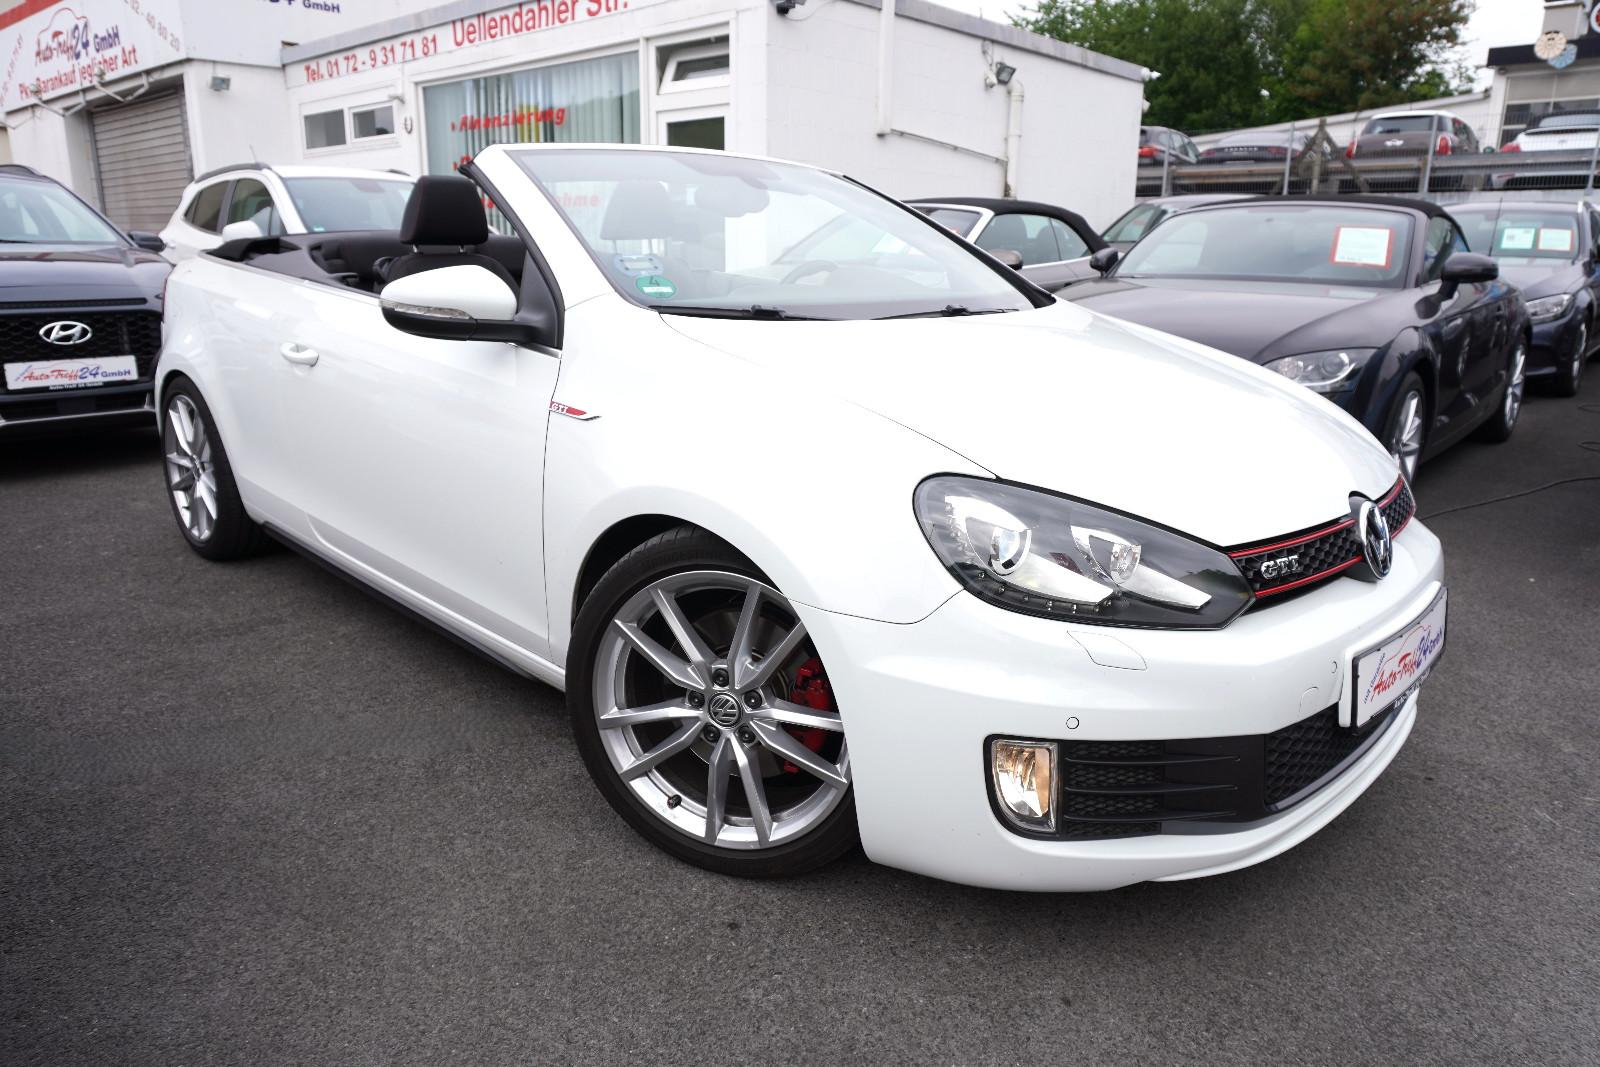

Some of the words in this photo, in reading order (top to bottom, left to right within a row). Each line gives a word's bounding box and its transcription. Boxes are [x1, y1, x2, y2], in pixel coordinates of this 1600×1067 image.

[303, 0, 340, 13] GmbH
[452, 0, 578, 47] Uellendahler
[94, 24, 120, 53] GmbH
[122, 44, 138, 68] Art
[304, 61, 324, 83] Tel.
[326, 58, 340, 78] 01
[344, 53, 358, 73] 72
[369, 49, 377, 68] 9
[381, 44, 396, 66] 31
[400, 38, 416, 62] 71
[421, 33, 438, 57] 81
[460, 107, 566, 132] Finanzierung
[101, 370, 131, 378] GmbH
[1261, 555, 1299, 580] GTI
